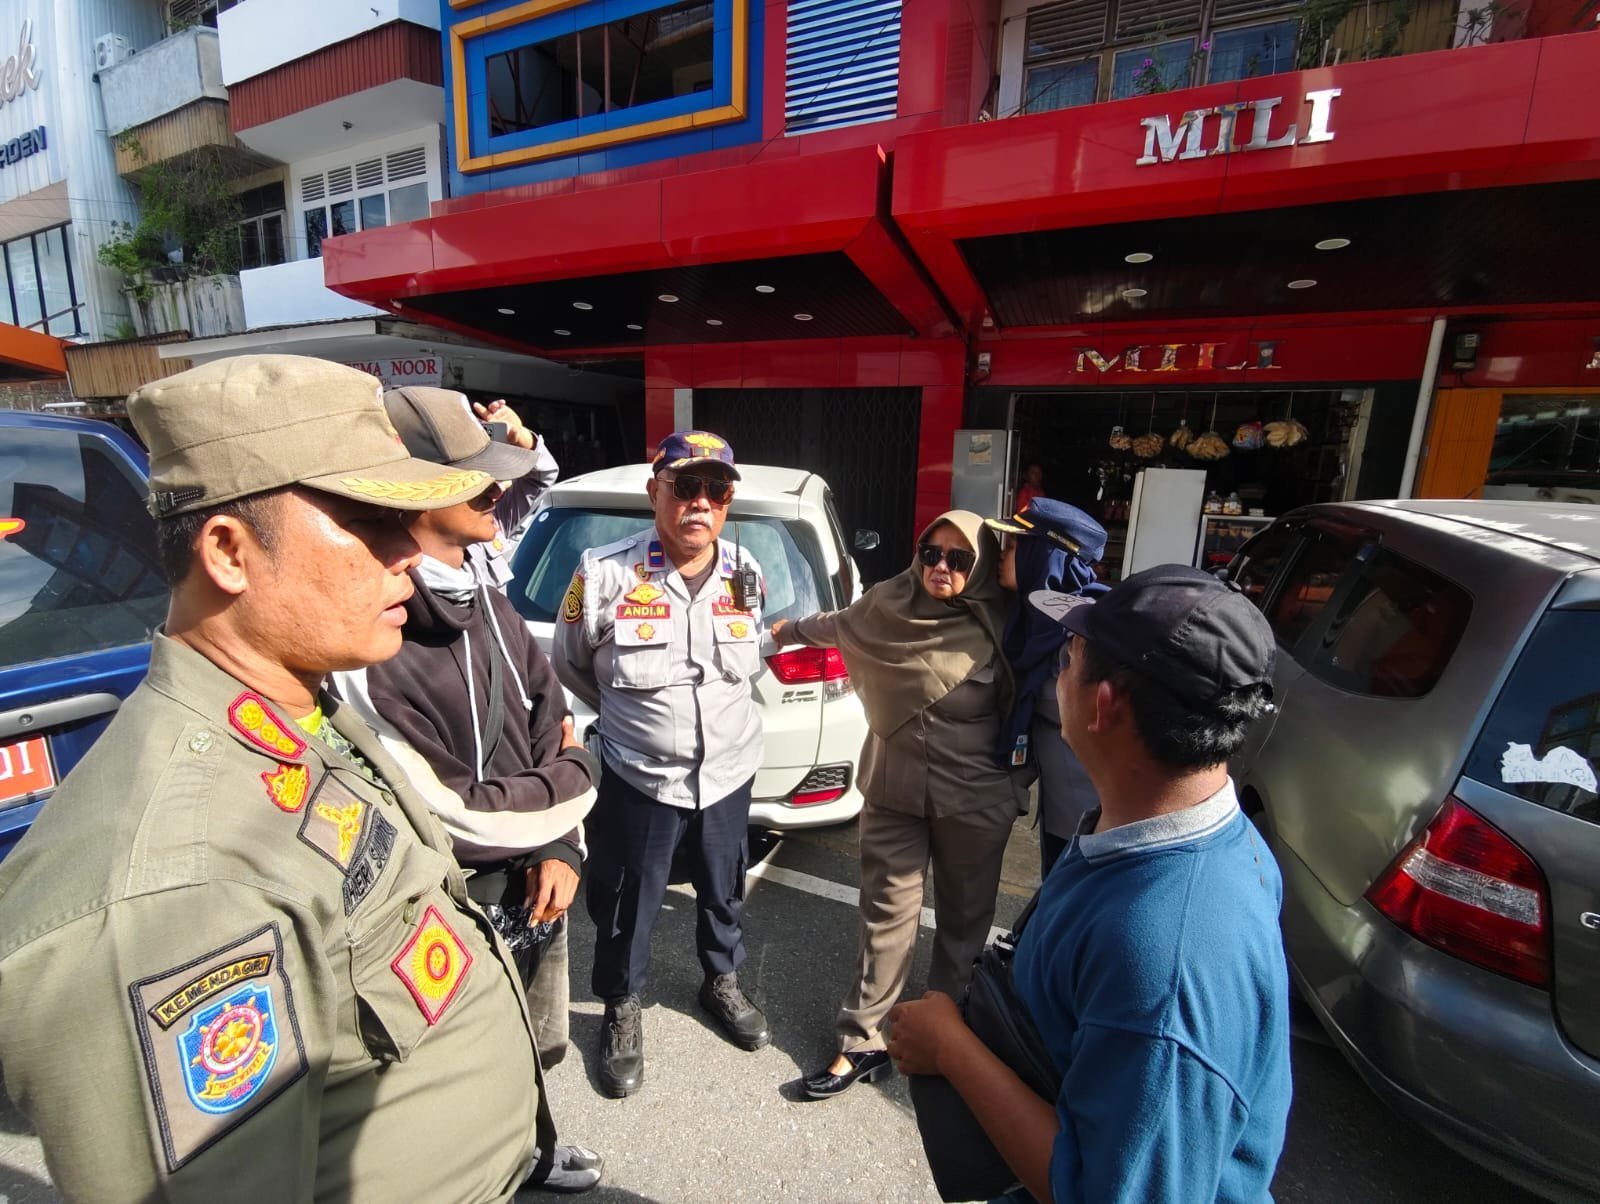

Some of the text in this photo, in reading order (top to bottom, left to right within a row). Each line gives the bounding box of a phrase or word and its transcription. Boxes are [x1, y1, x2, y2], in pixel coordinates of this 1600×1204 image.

[1135, 88, 1342, 166] MILI
[391, 359, 438, 376] NOOR
[1070, 340, 1288, 373] MILI
[623, 606, 666, 616] ANDI.M
[161, 958, 266, 1017] KEMENDAGRI
